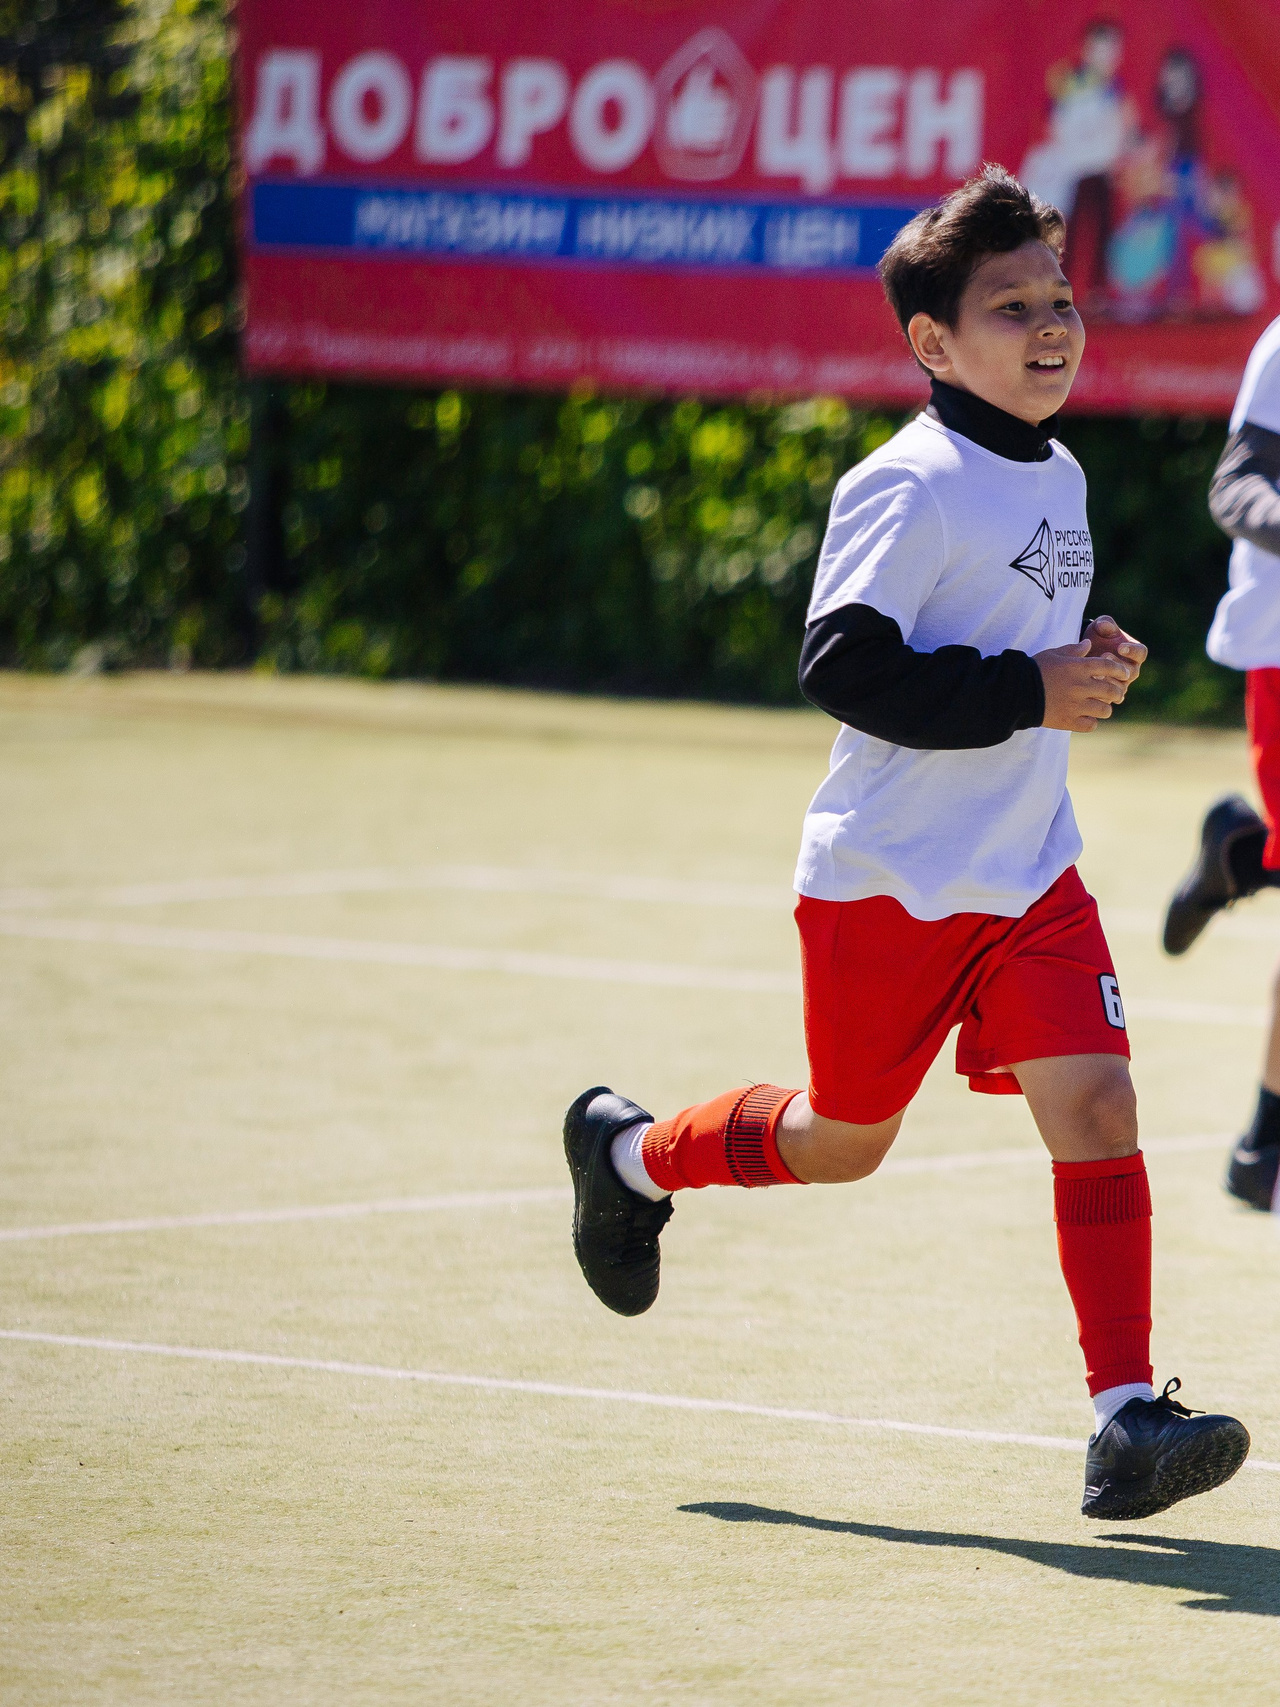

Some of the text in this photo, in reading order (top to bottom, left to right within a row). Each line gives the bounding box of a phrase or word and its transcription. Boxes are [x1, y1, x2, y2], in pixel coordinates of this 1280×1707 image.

[247, 49, 986, 194] ДОБРО ЦЕН
[764, 209, 861, 268] ЦЕН
[1097, 971, 1125, 1030] 6
